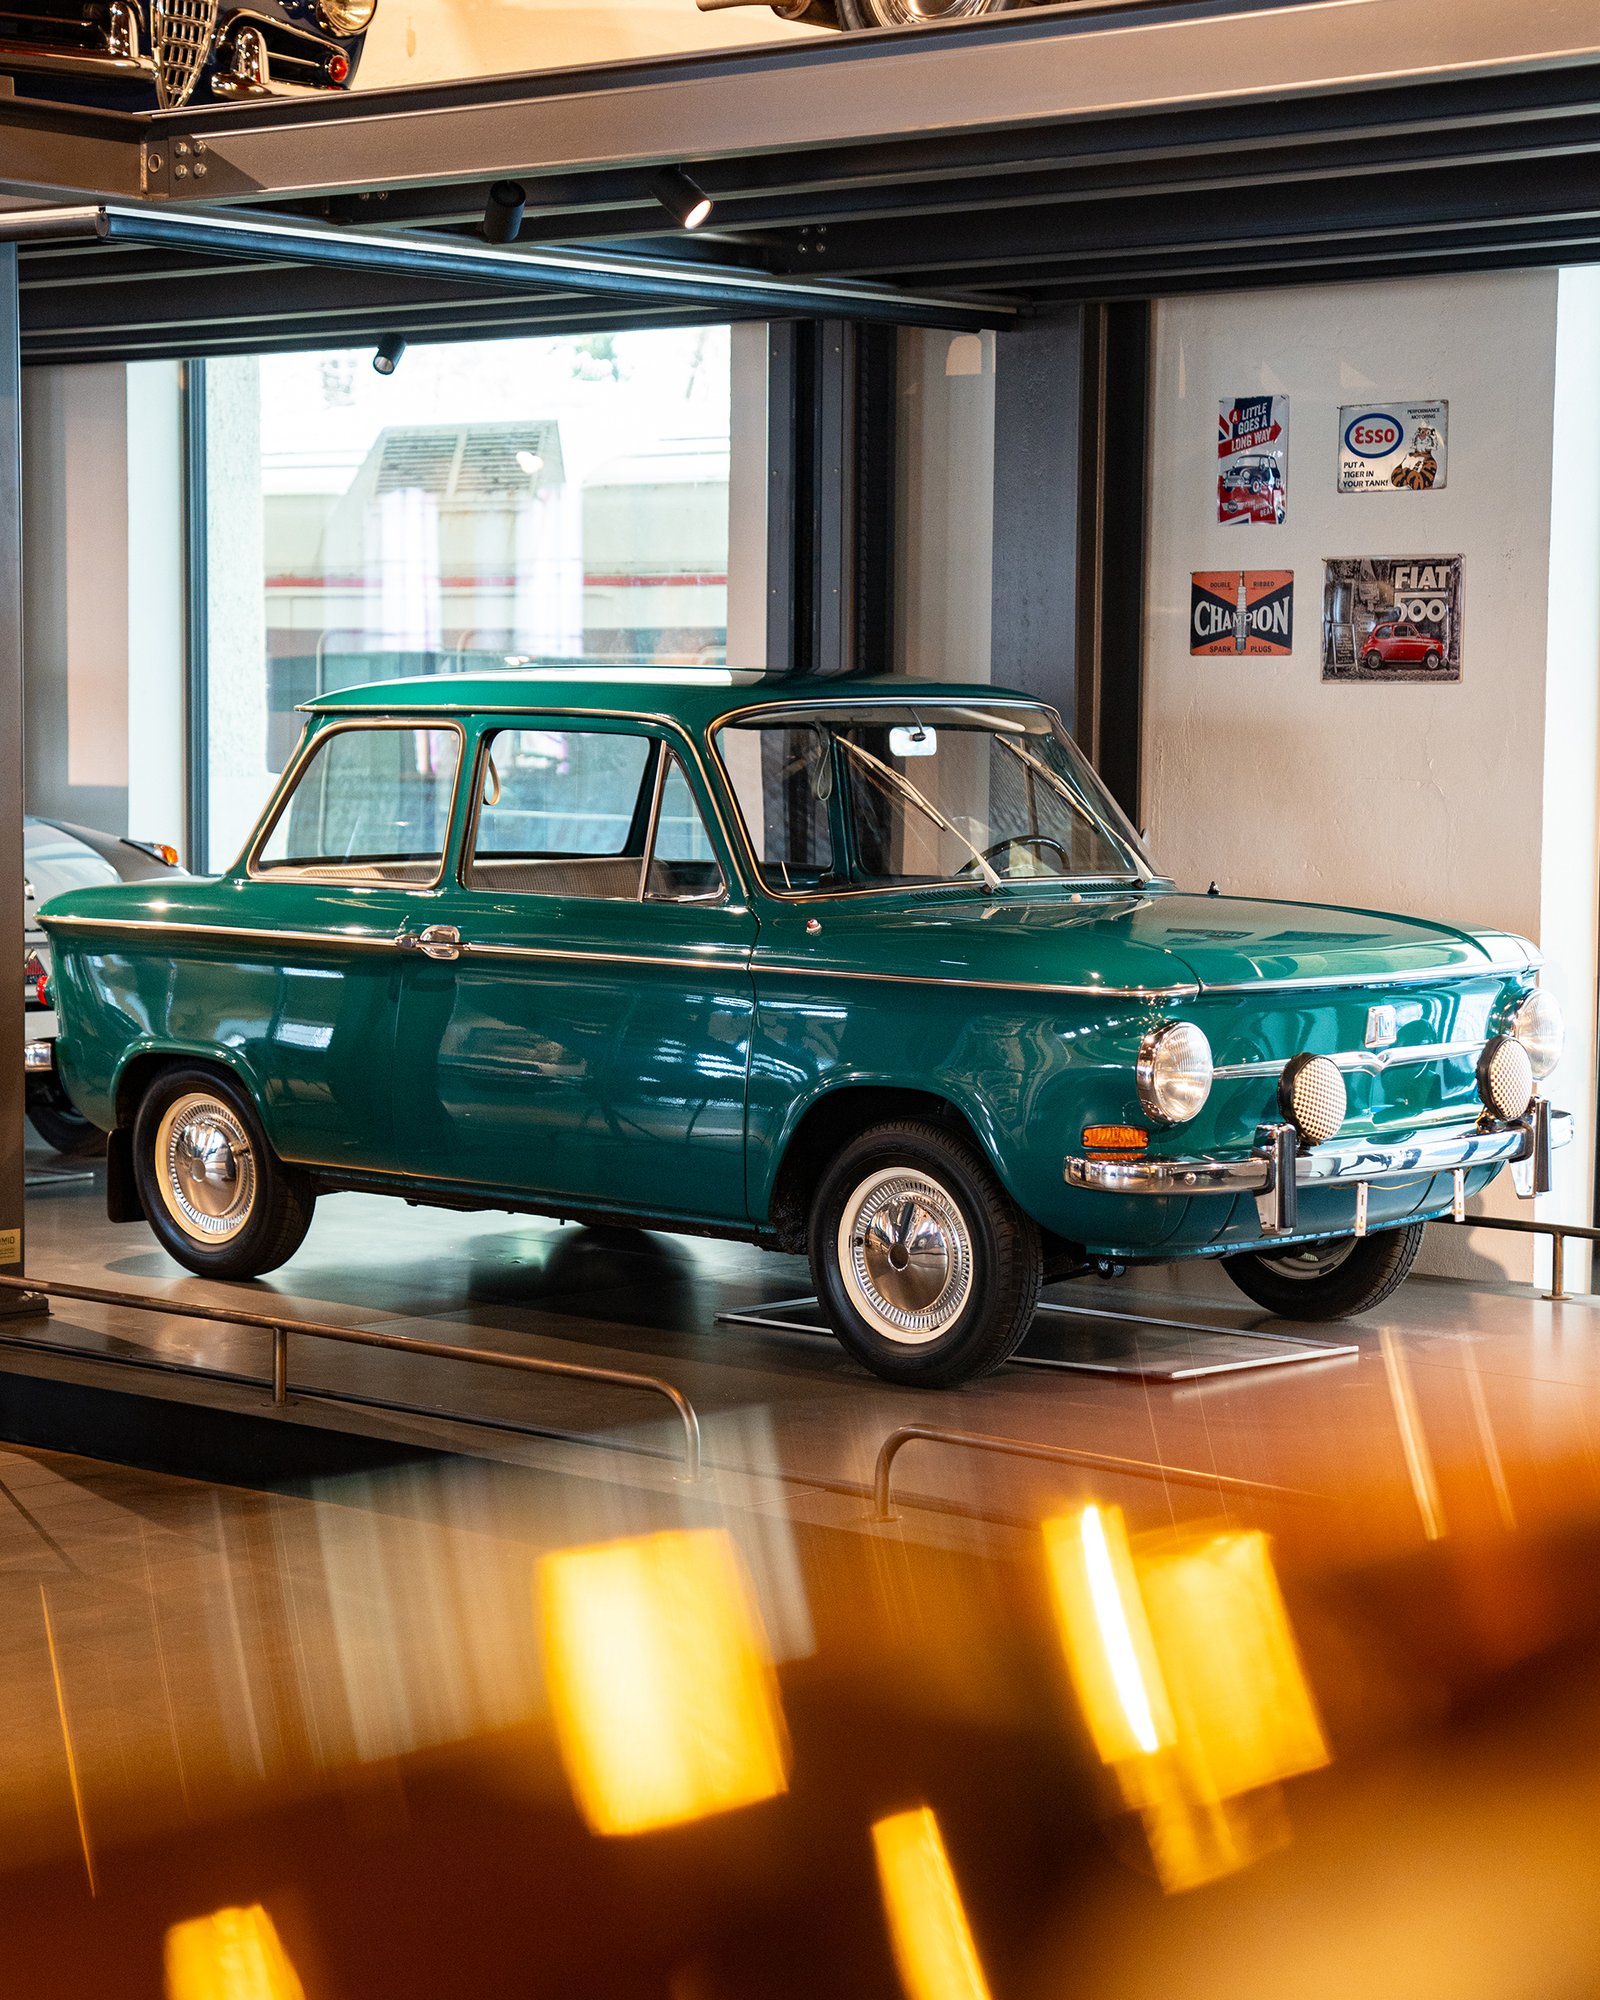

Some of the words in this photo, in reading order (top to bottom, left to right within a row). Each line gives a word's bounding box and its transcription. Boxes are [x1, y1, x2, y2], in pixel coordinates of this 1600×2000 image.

[1242, 402, 1268, 419] LITTLE
[1238, 418, 1260, 435] GOES
[1261, 415, 1268, 427] A
[1231, 436, 1252, 452] LONG
[1254, 427, 1272, 445] WAY
[1343, 461, 1358, 469] PUT
[1343, 471, 1364, 479] TIGER
[1365, 479, 1388, 487] TANK!
[1394, 565, 1451, 589] FIAT
[1194, 596, 1290, 637] CHAMPION
[1250, 645, 1272, 653] PLUGS
